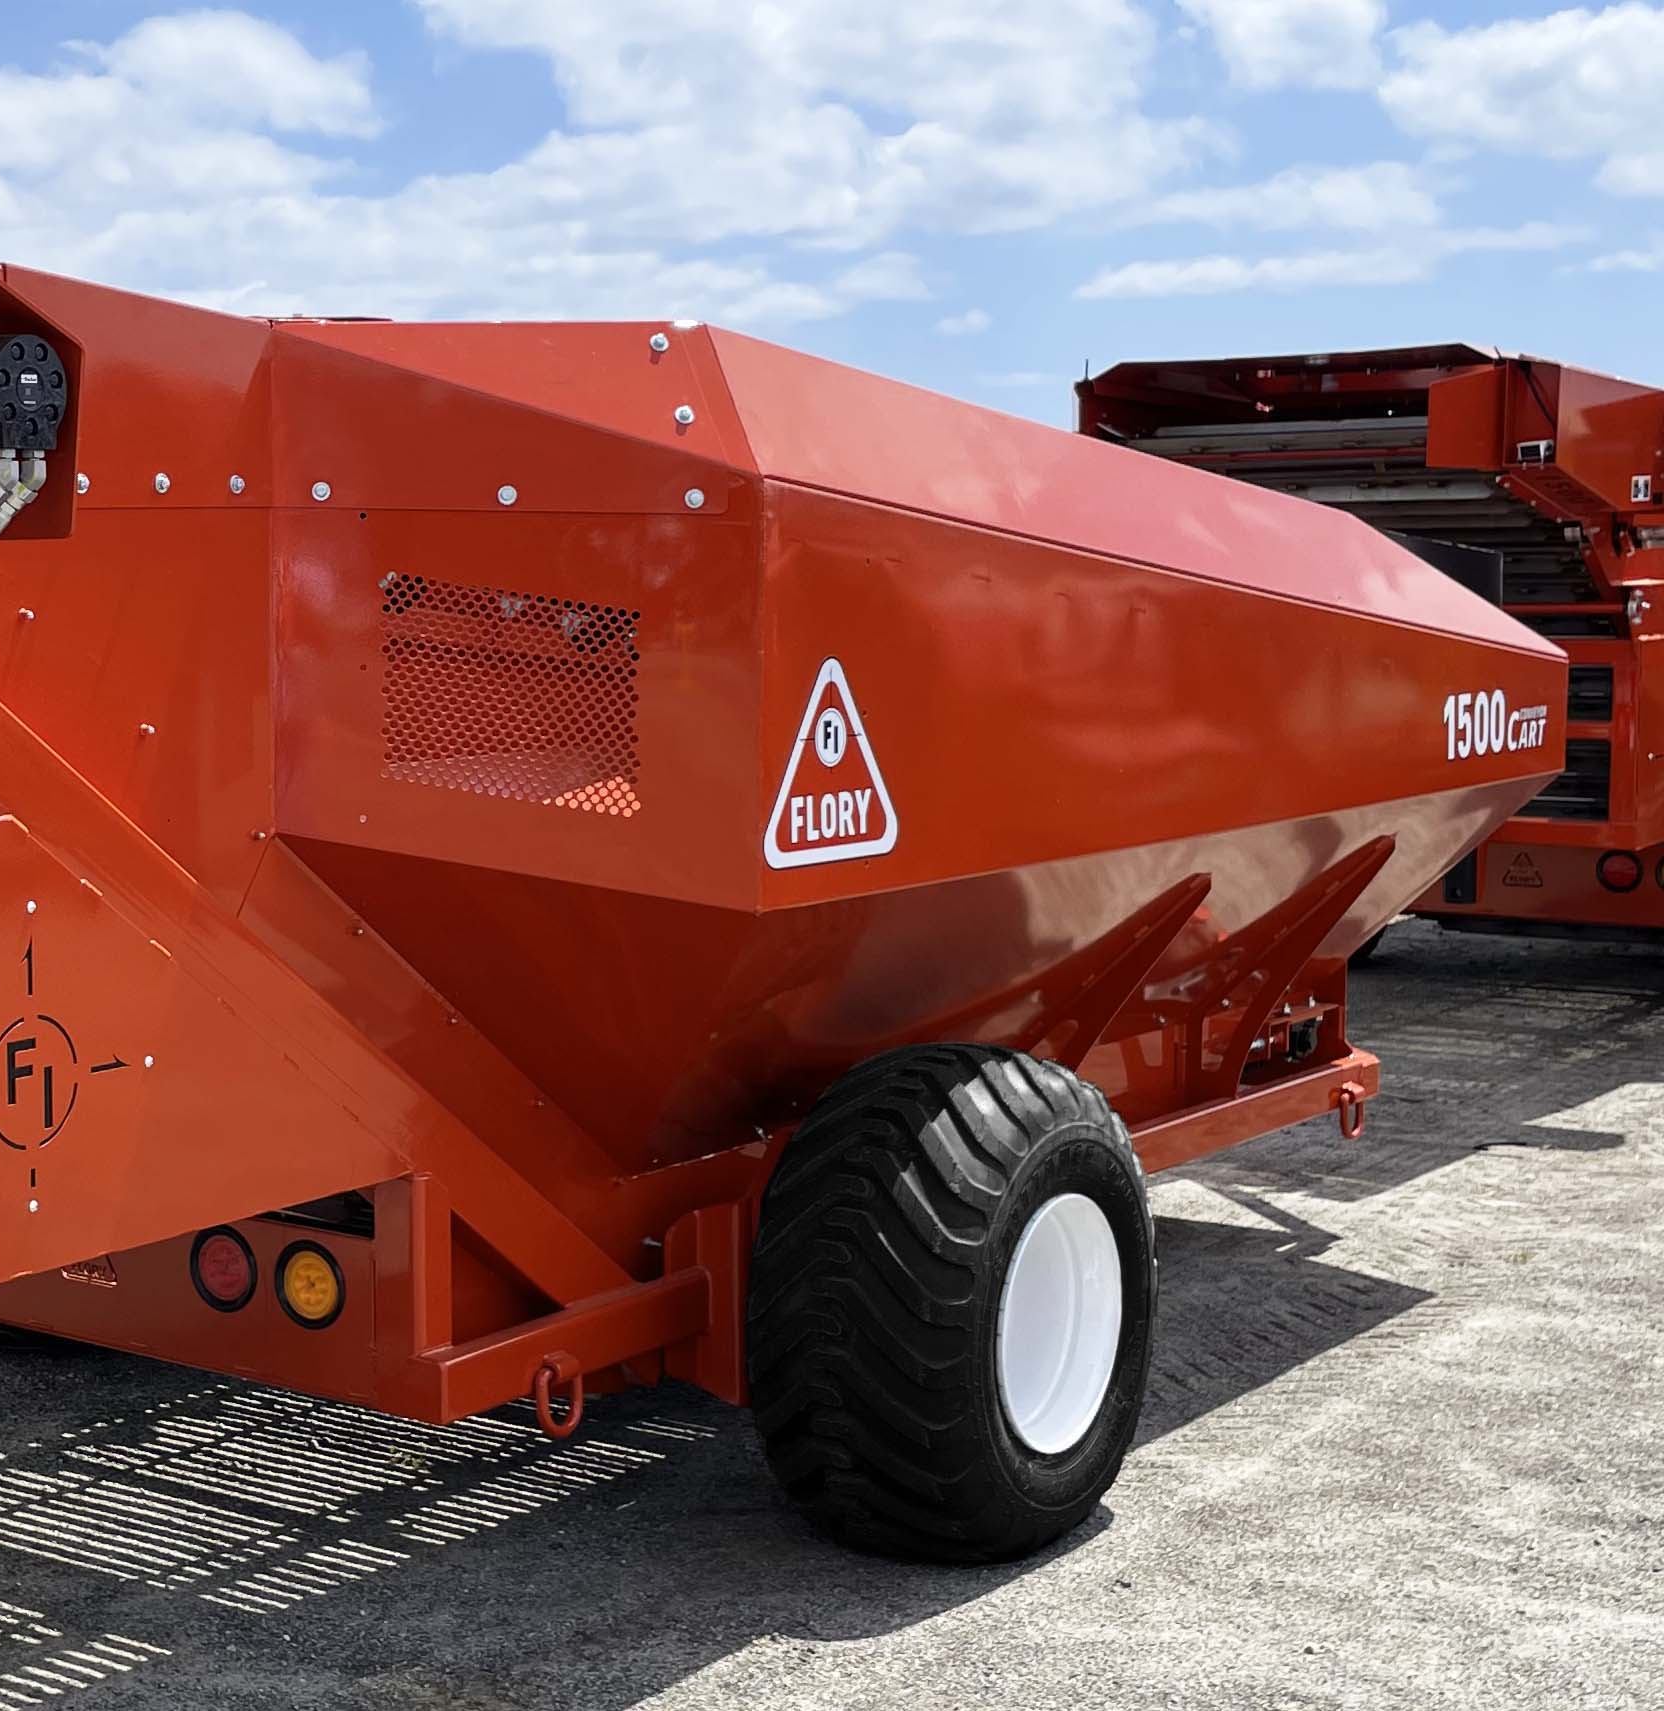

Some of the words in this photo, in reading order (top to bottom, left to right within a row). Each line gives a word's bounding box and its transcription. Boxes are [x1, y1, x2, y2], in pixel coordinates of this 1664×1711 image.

[823, 720, 839, 754] FI
[1443, 689, 1506, 760] 1500
[1507, 710, 1546, 751] CART
[790, 788, 872, 843] FLORY
[7, 1037, 54, 1129] FI
